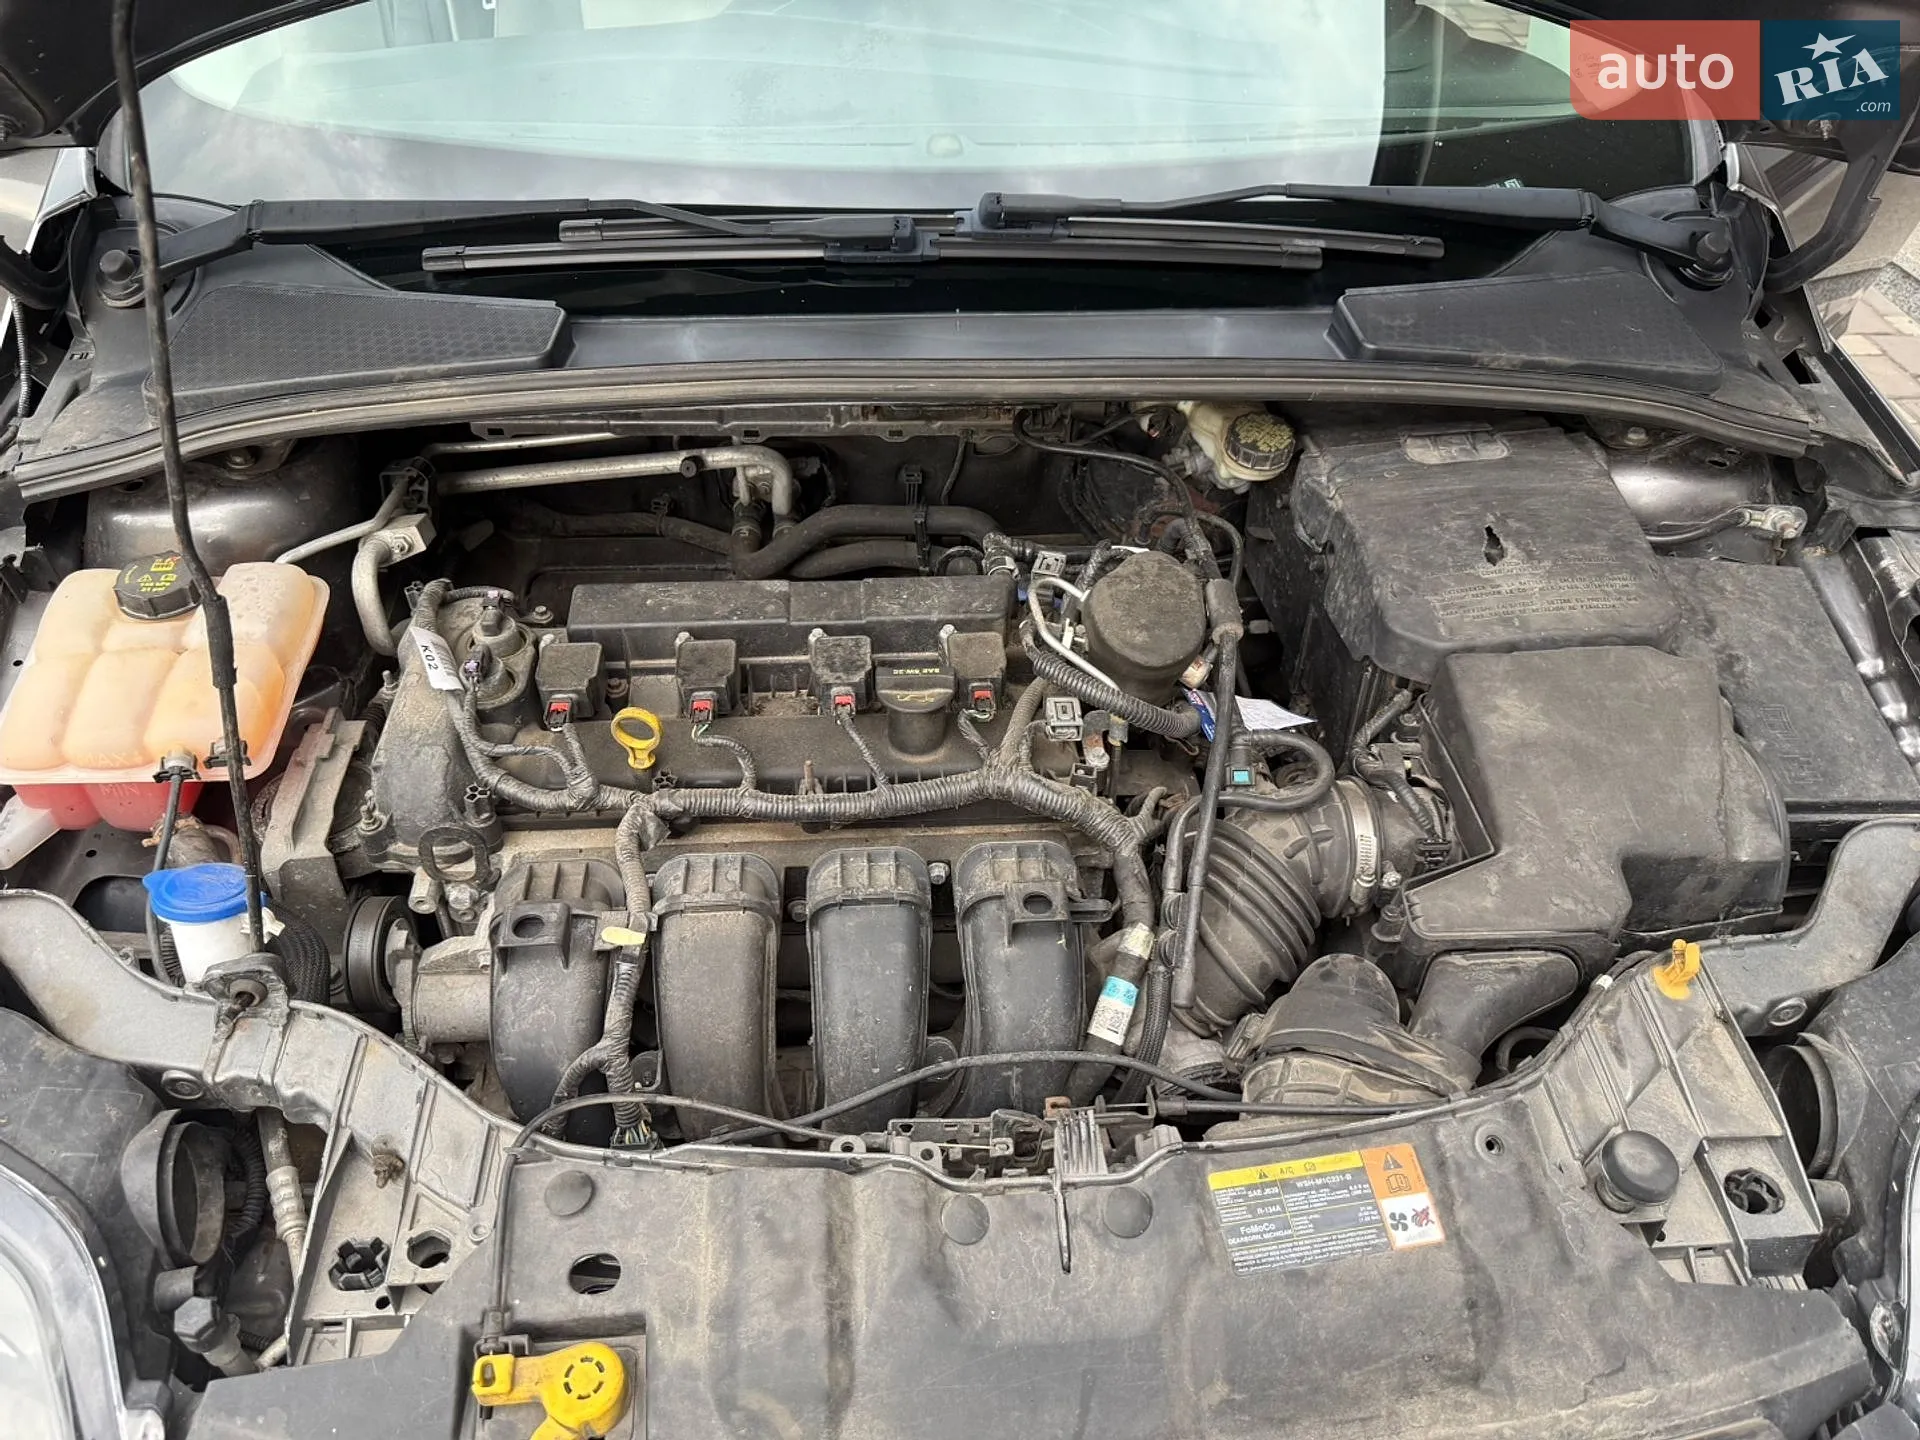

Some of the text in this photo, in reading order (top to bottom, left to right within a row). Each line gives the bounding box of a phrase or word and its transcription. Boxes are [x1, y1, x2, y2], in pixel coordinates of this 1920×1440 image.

[421, 645, 439, 670] K02
[1256, 1204, 1282, 1215] R-134A
[1240, 1222, 1276, 1235] FoMoCo
